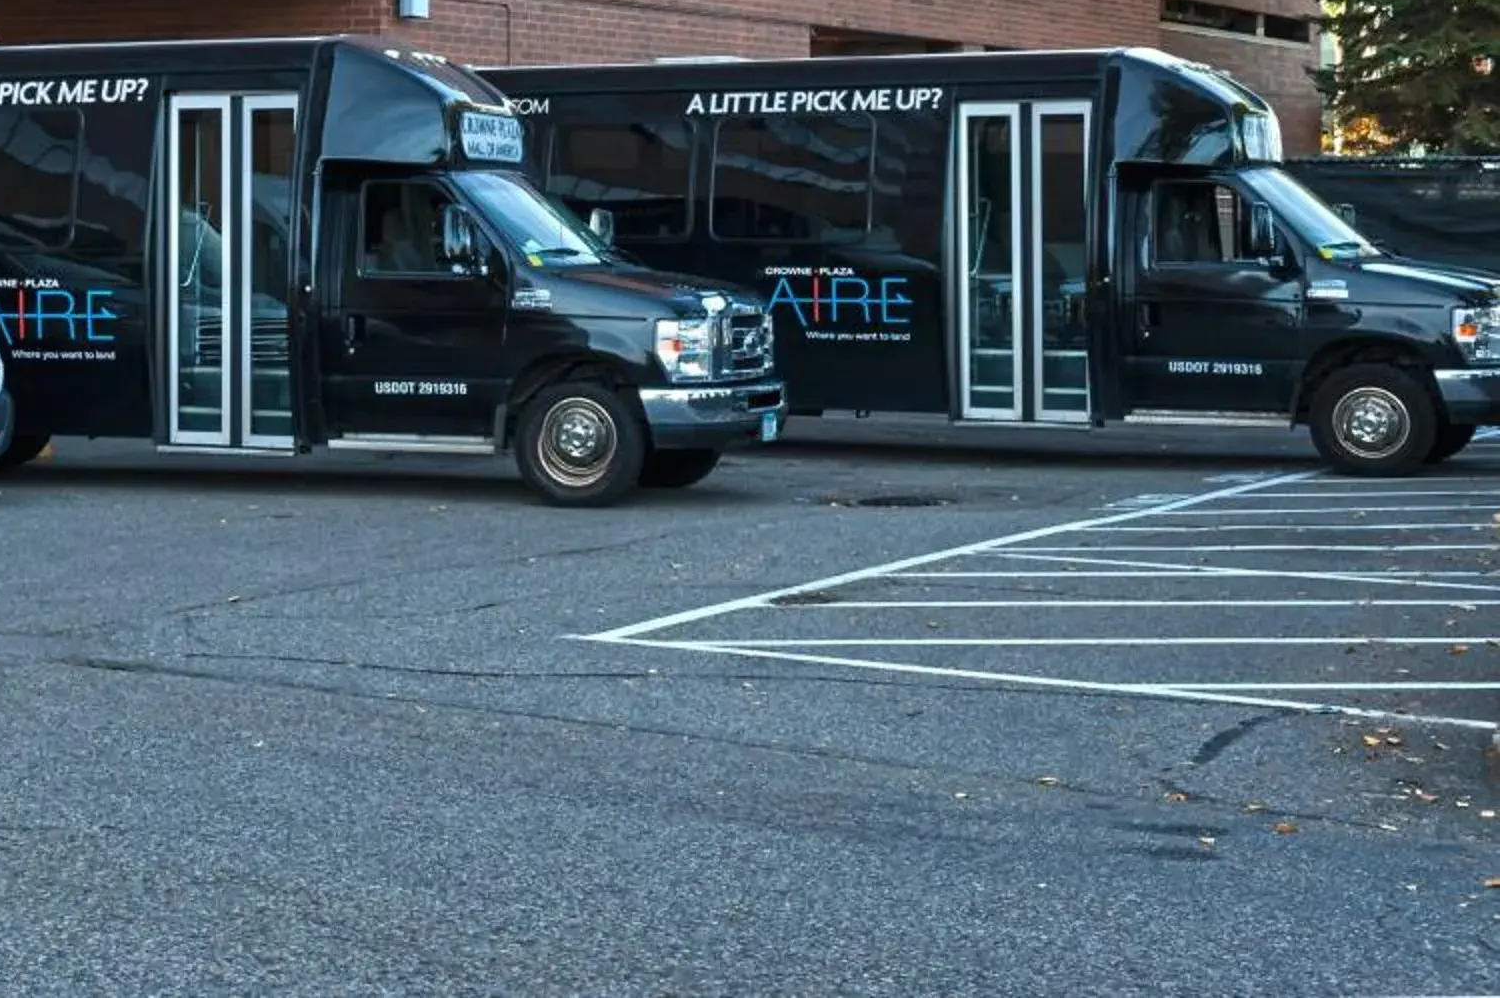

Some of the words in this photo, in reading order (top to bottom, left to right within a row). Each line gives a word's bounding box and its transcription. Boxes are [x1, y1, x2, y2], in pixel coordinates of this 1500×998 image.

[57, 79, 97, 104] ME
[101, 77, 149, 103] UP?
[685, 93, 705, 115] A
[709, 92, 788, 114] LITTLE
[791, 90, 849, 112] PICK
[851, 89, 891, 111] ME
[895, 88, 943, 110] UP?
[765, 266, 812, 276] CROWNE
[819, 267, 855, 277] PLAZA
[25, 278, 60, 289] PLAZA
[766, 277, 913, 327] AIRE
[1168, 361, 1210, 374] USDOT
[374, 381, 415, 395] USDOT
